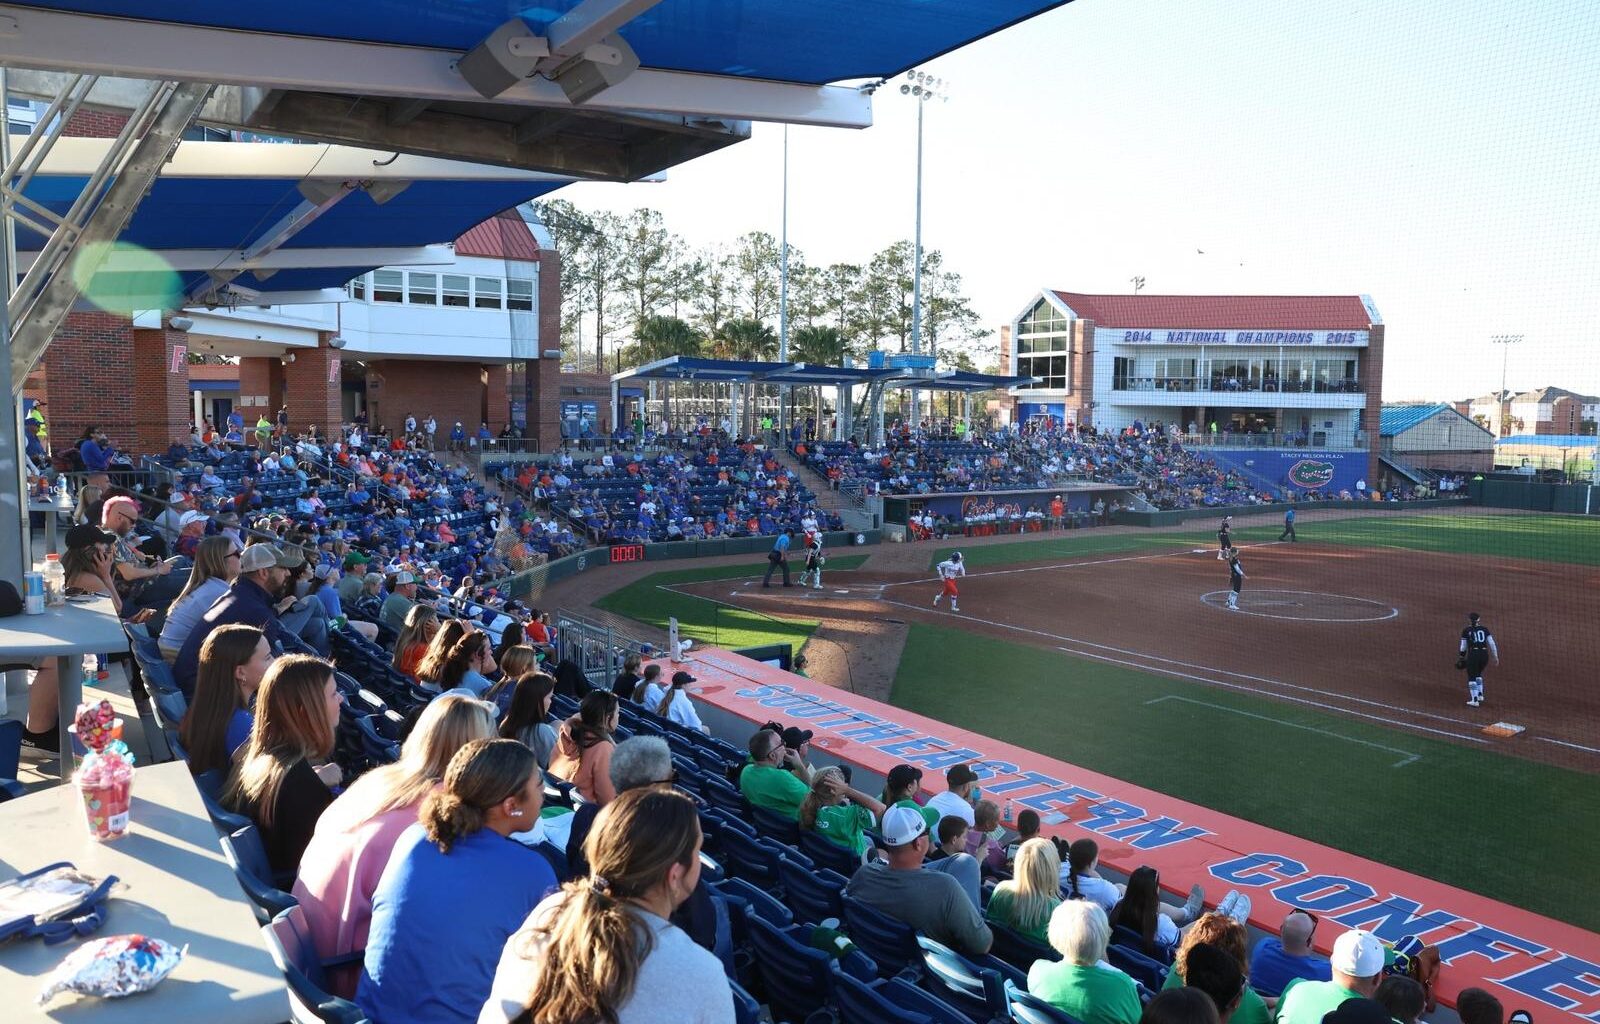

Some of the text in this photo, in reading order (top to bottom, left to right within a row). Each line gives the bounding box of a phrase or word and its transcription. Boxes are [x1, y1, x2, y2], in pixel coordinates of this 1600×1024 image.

[1124, 331, 1356, 344] 2014 NATIONAL CHAMPIONS 2015
[170, 345, 187, 373] F
[329, 359, 341, 383] F
[1473, 630, 1485, 642] 10
[735, 684, 1600, 1024] SOUTHEASTERN CONFE
